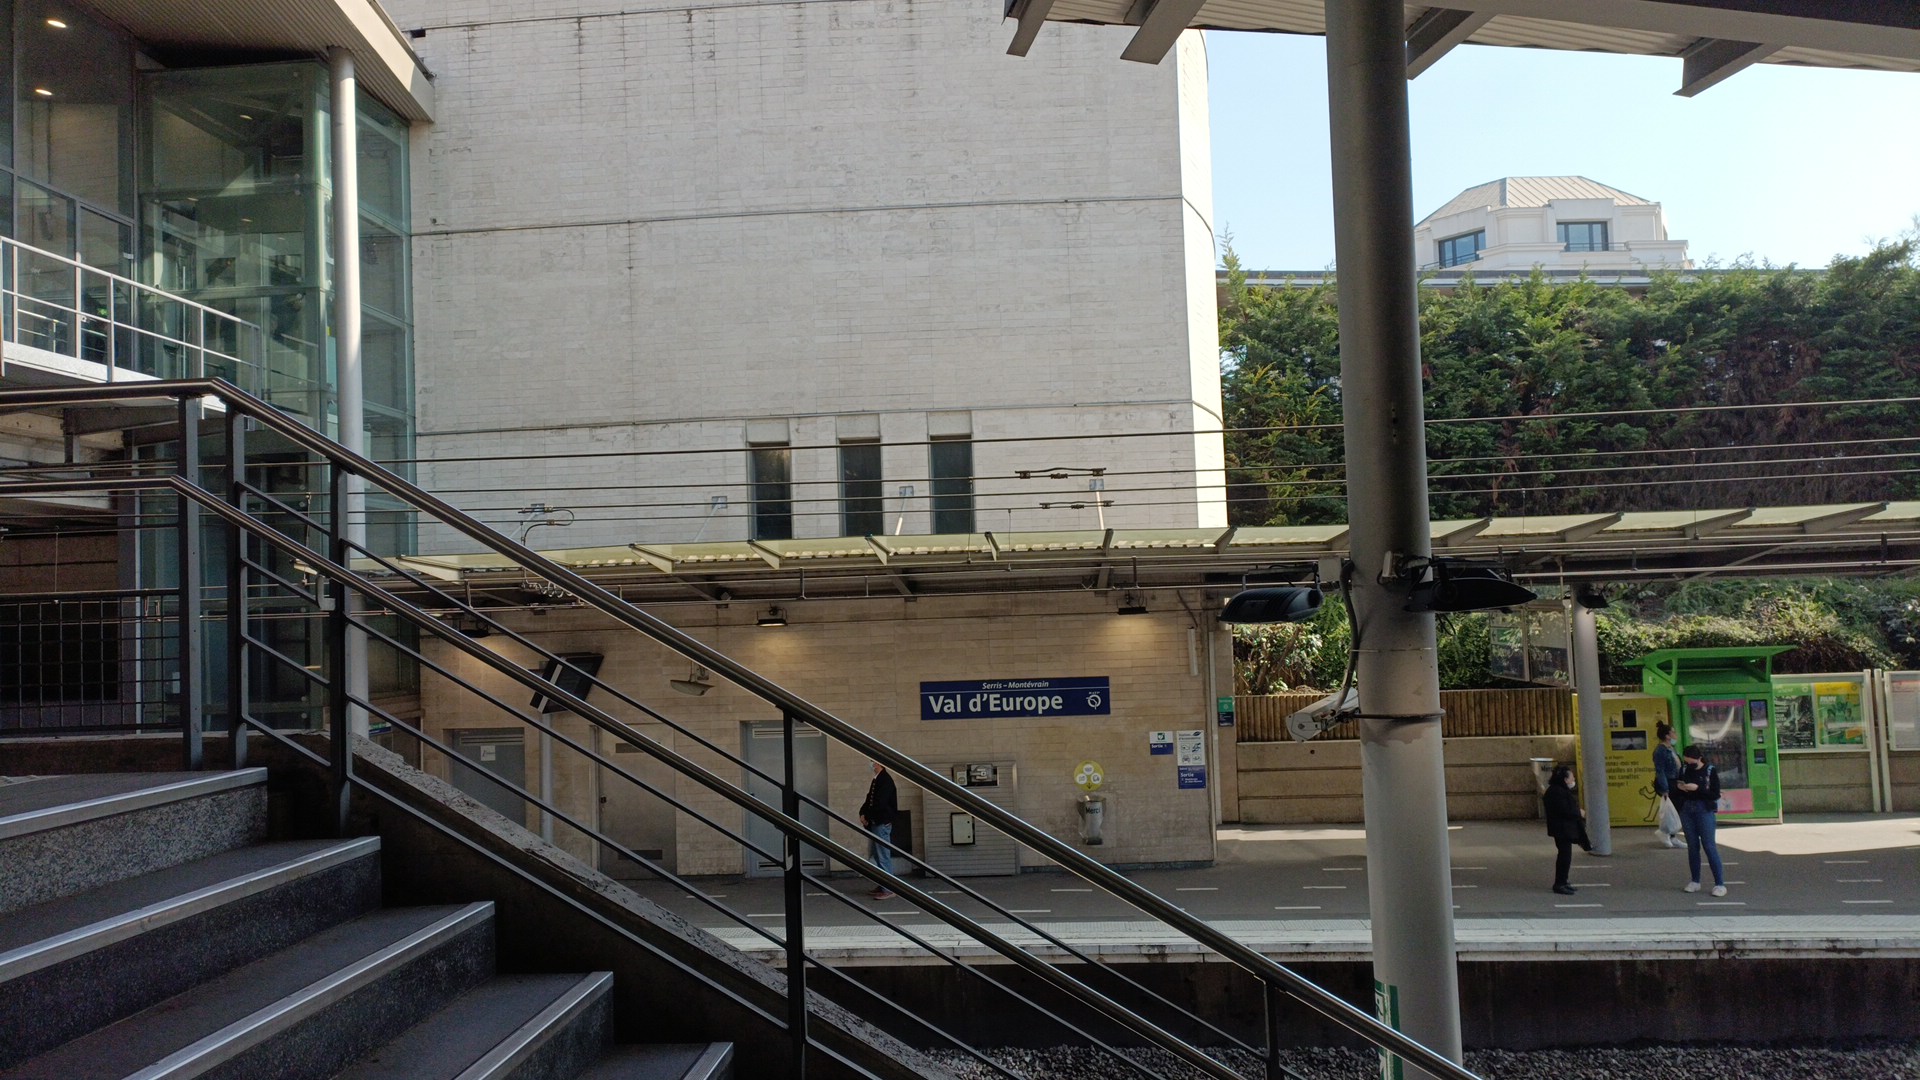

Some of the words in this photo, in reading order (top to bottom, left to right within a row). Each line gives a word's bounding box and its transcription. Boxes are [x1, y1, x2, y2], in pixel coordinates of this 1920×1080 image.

[982, 682, 1002, 690] Serris
[1008, 680, 1049, 689] Montévrain
[928, 694, 962, 713] Val
[968, 693, 1063, 714] d'Europe
